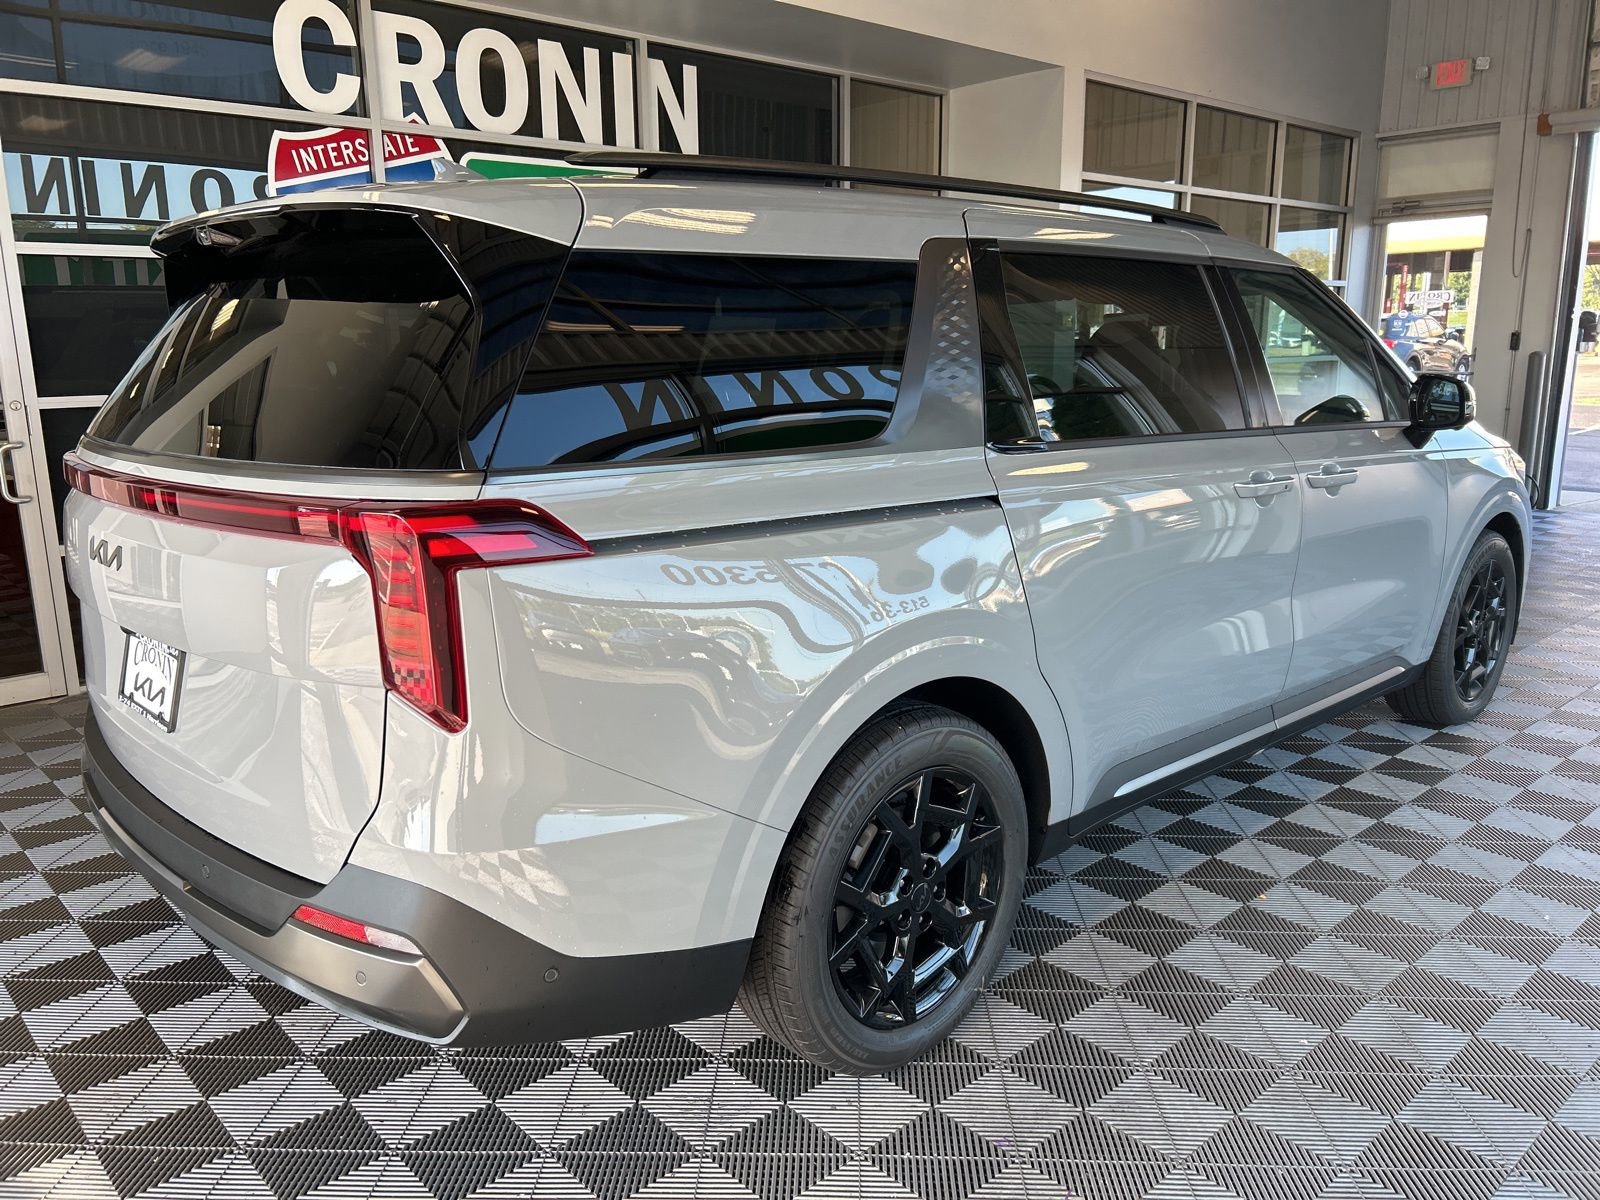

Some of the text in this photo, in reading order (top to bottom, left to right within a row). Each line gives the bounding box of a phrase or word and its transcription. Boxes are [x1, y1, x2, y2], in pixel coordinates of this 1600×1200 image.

[272, 0, 699, 155] CRONIN
[89, 535, 122, 571] KIA
[134, 641, 174, 686] CRONIN
[134, 672, 166, 707] KIA
